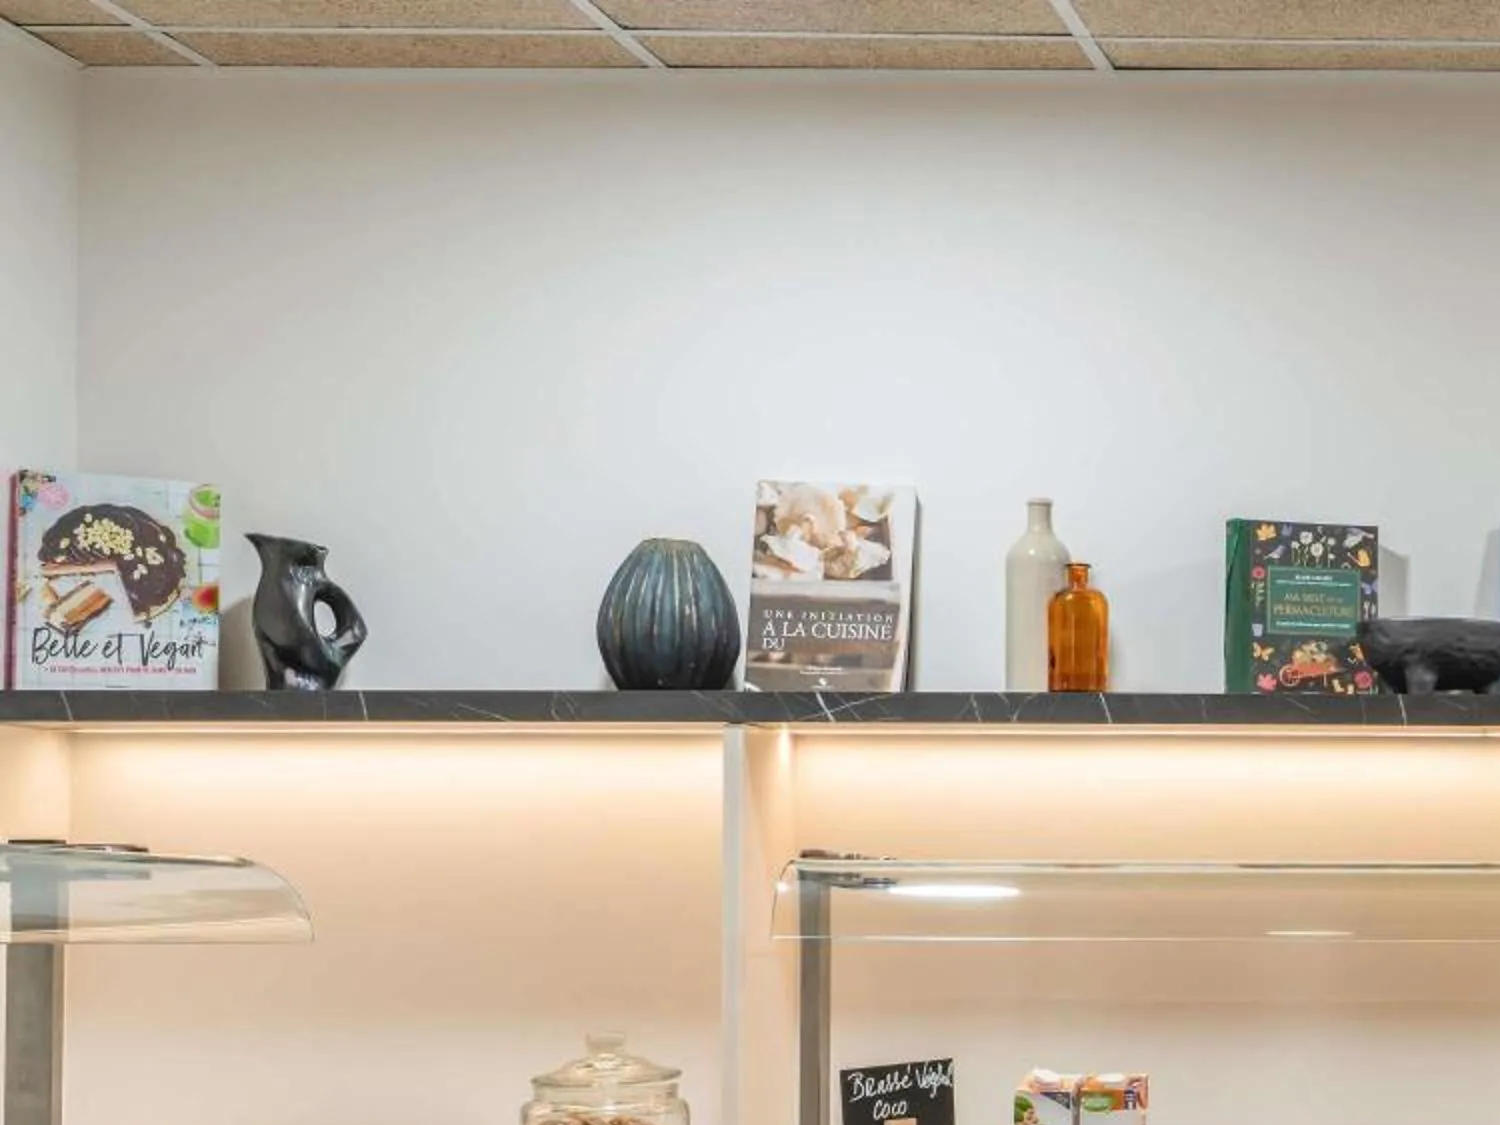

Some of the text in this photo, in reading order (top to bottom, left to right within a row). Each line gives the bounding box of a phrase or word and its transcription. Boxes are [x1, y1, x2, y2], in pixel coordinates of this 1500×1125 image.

[32, 623, 98, 665] Belle
[101, 631, 141, 665] et
[781, 621, 806, 638] LA
[811, 621, 893, 641] CUISINE
